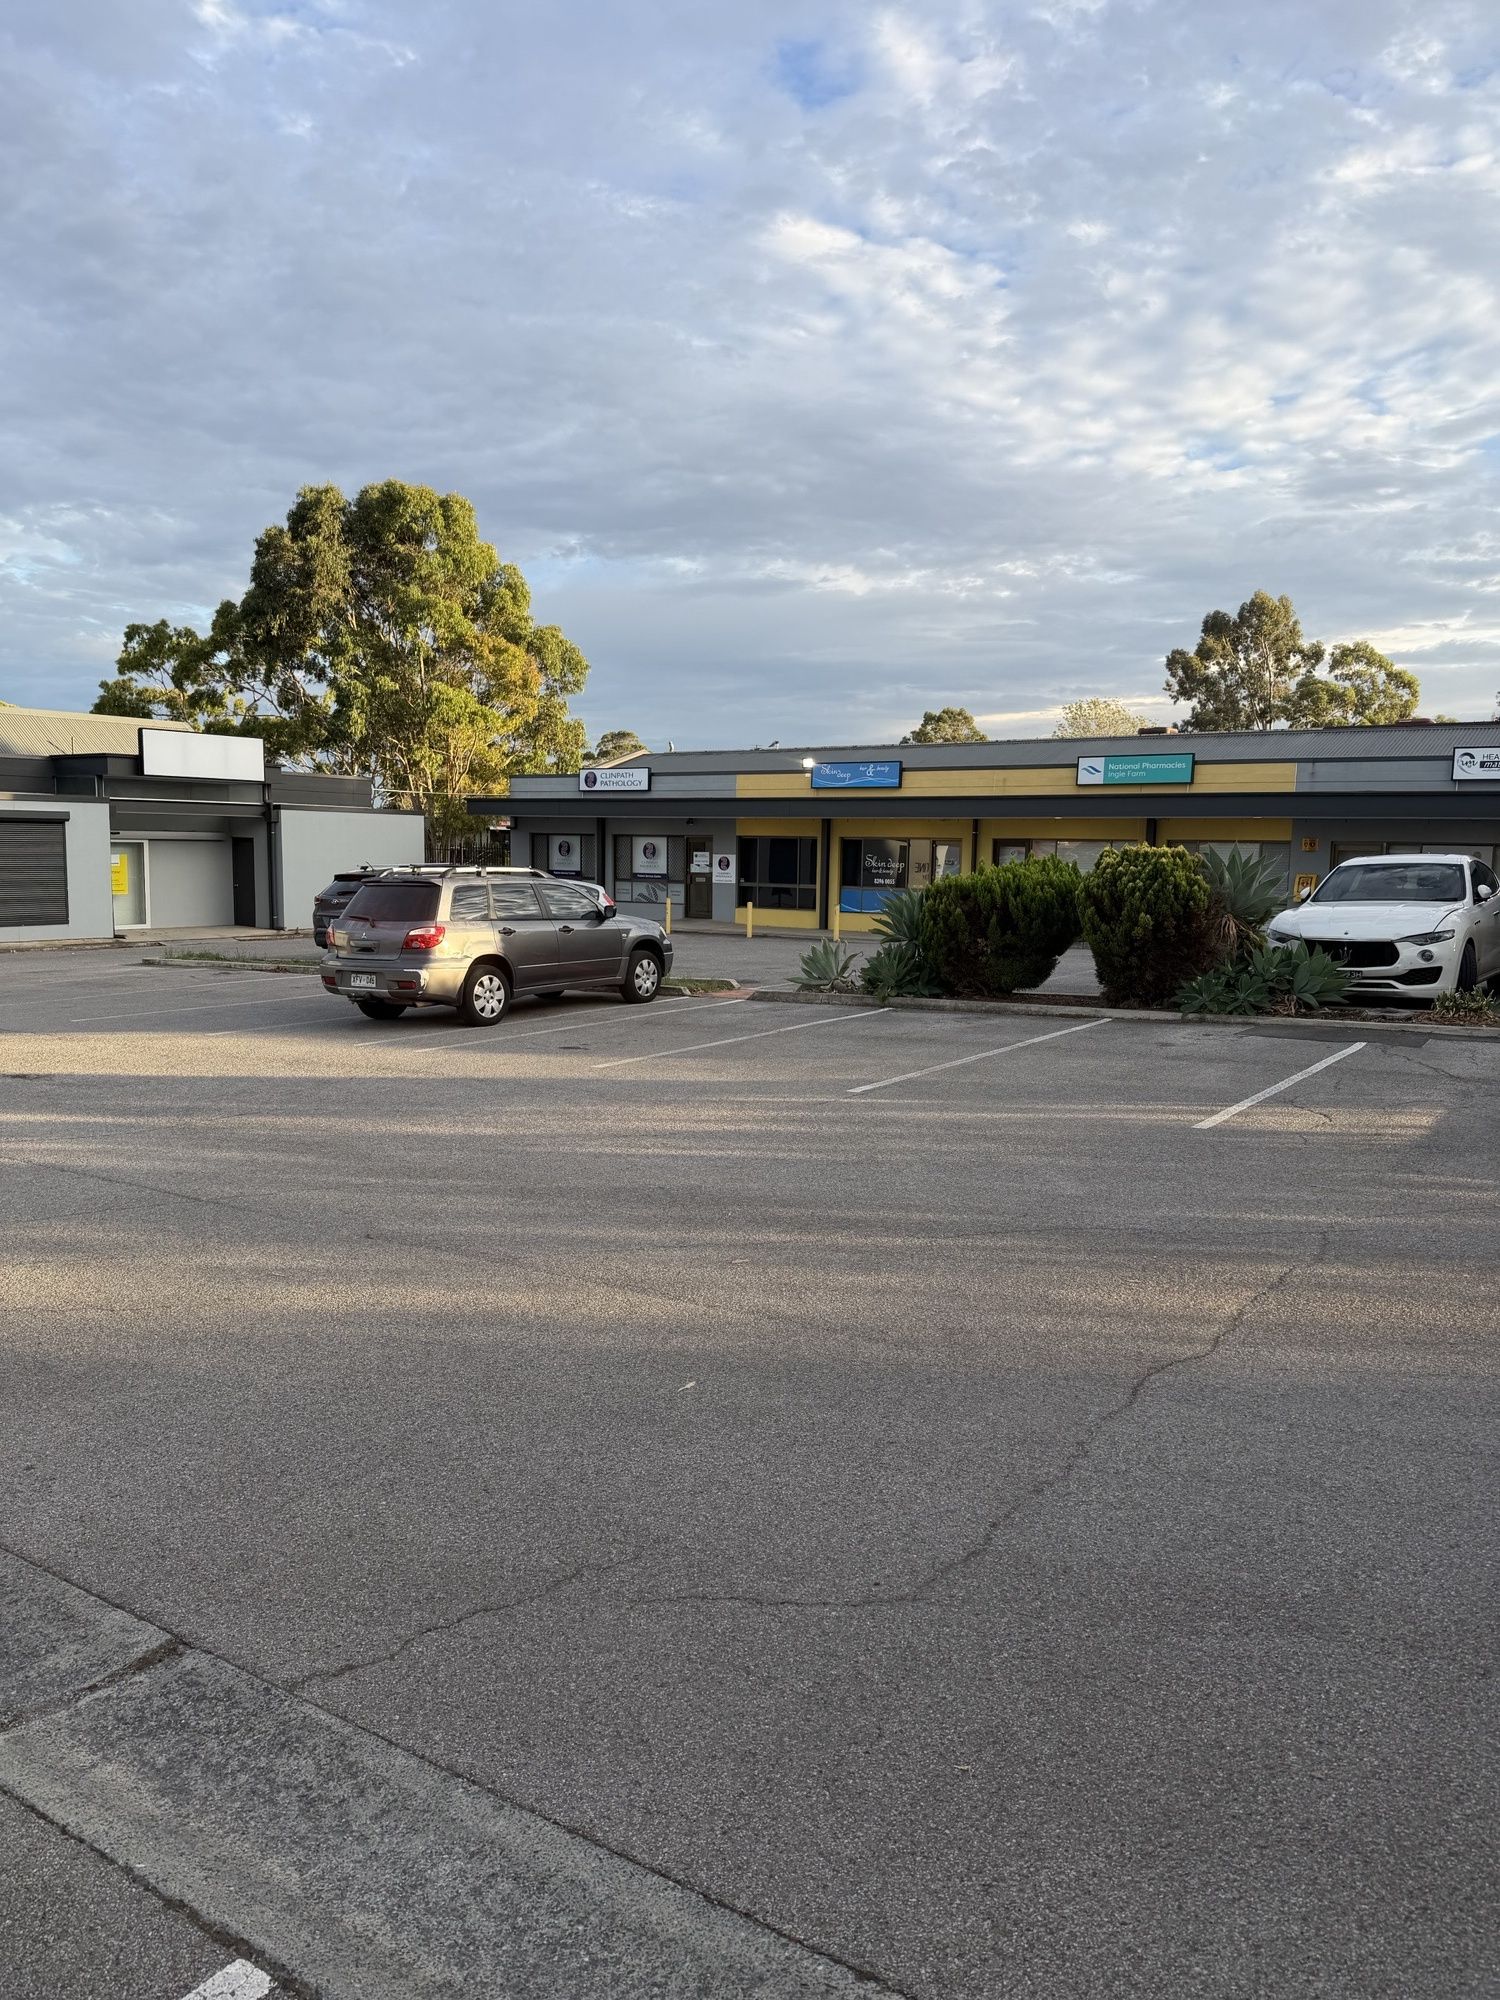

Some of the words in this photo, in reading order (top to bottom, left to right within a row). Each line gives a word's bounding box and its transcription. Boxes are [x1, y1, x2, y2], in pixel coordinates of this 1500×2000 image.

[866, 764, 876, 777] &
[1108, 762, 1140, 770] National
[1142, 761, 1186, 769] Pharmacies
[820, 764, 837, 775] Skin
[837, 770, 851, 782] deep
[1108, 770, 1126, 779] Ingle
[865, 854, 886, 867] Skin
[887, 858, 905, 873] deep
